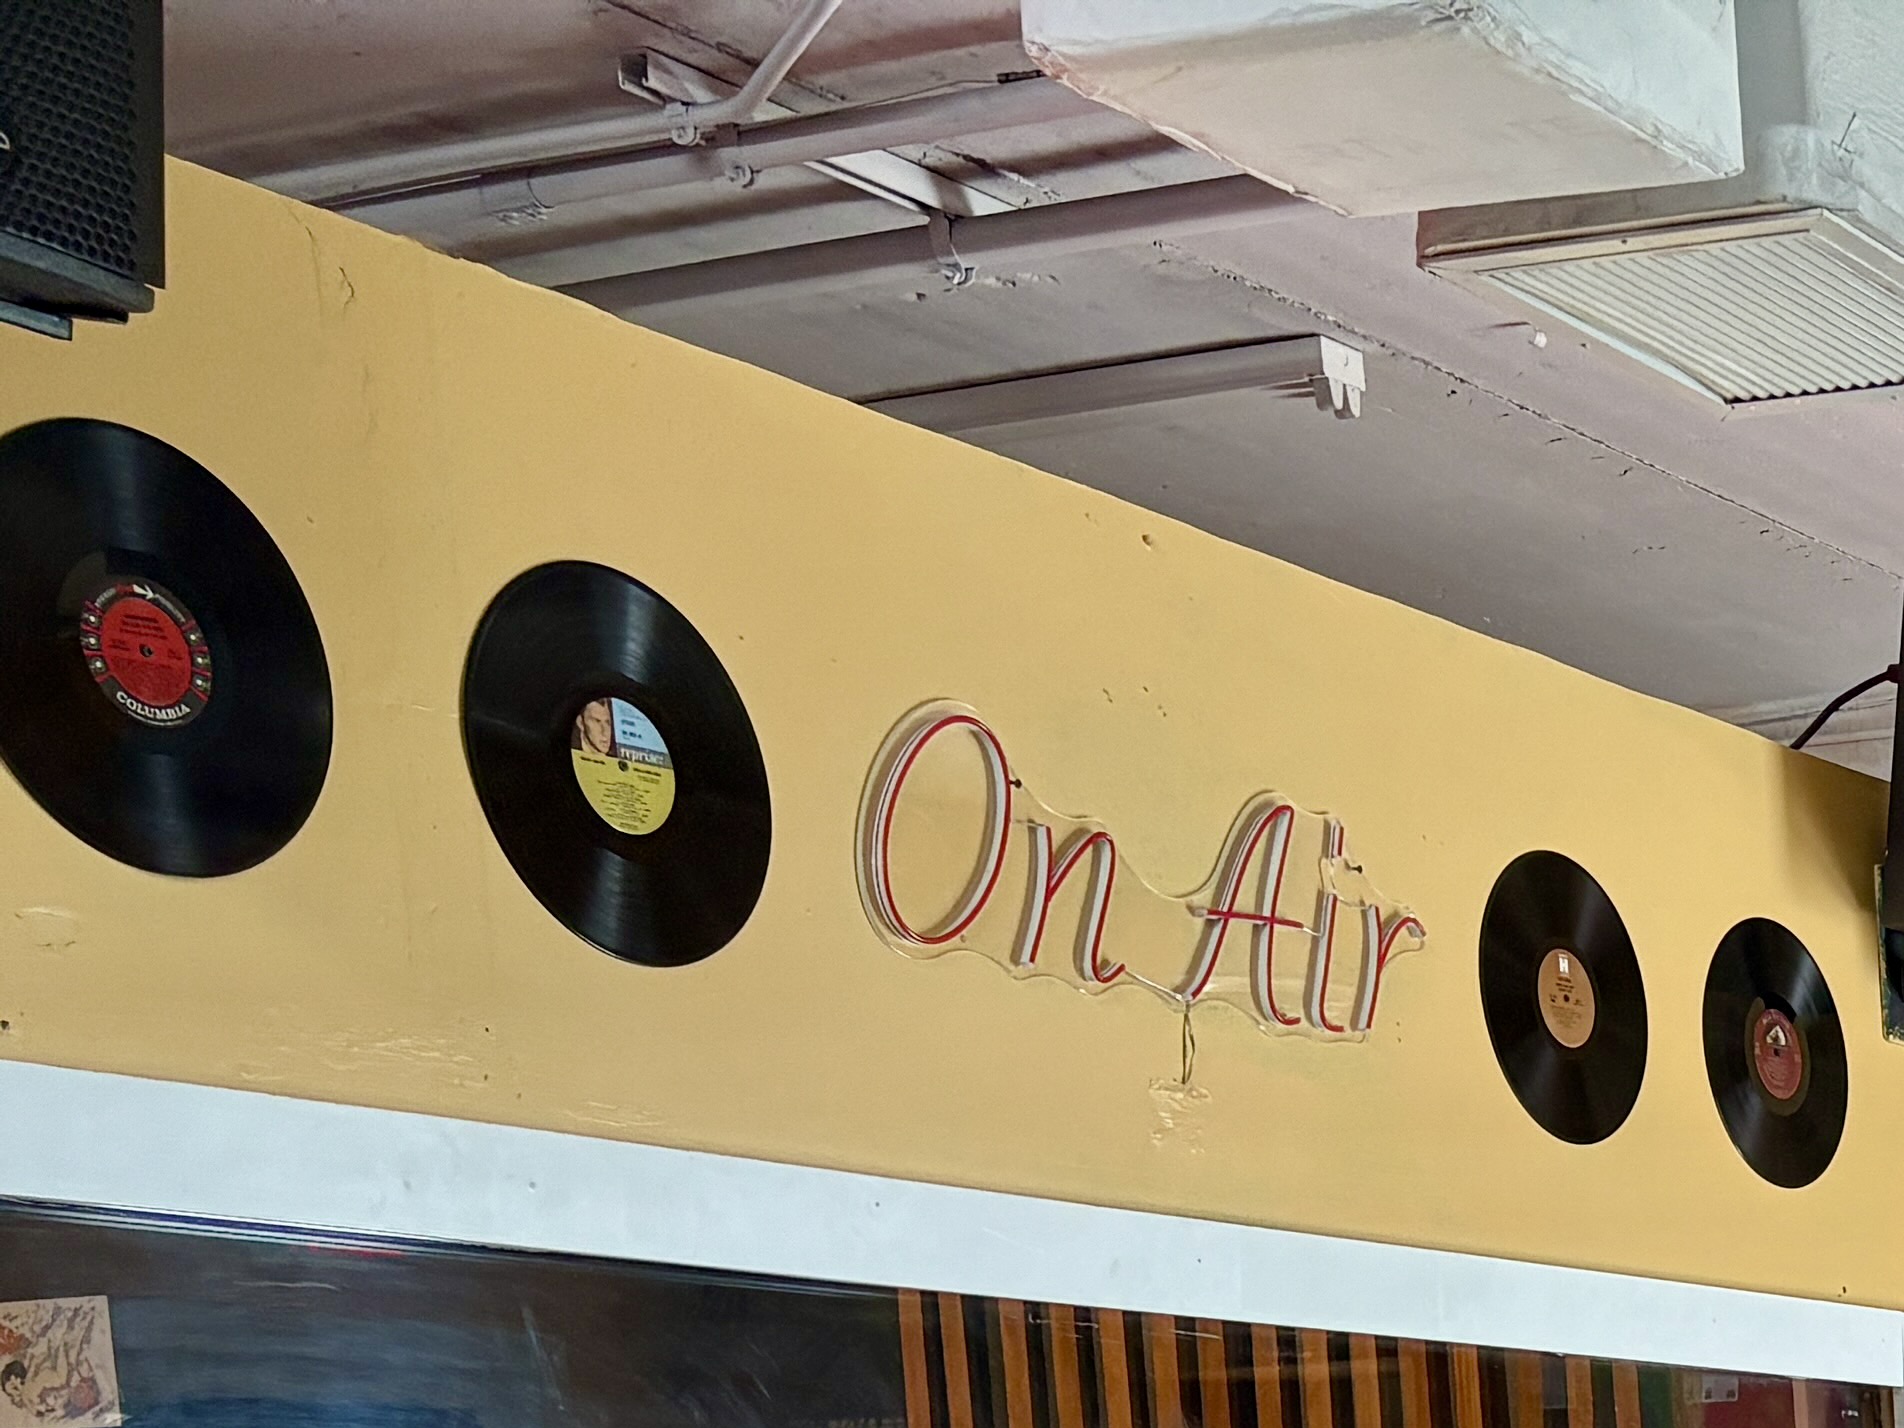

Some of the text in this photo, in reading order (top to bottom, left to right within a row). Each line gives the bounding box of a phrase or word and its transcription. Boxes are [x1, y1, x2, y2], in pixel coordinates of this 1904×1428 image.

[115, 690, 192, 721] COLUMBIA
[871, 712, 1427, 1034] On Air
